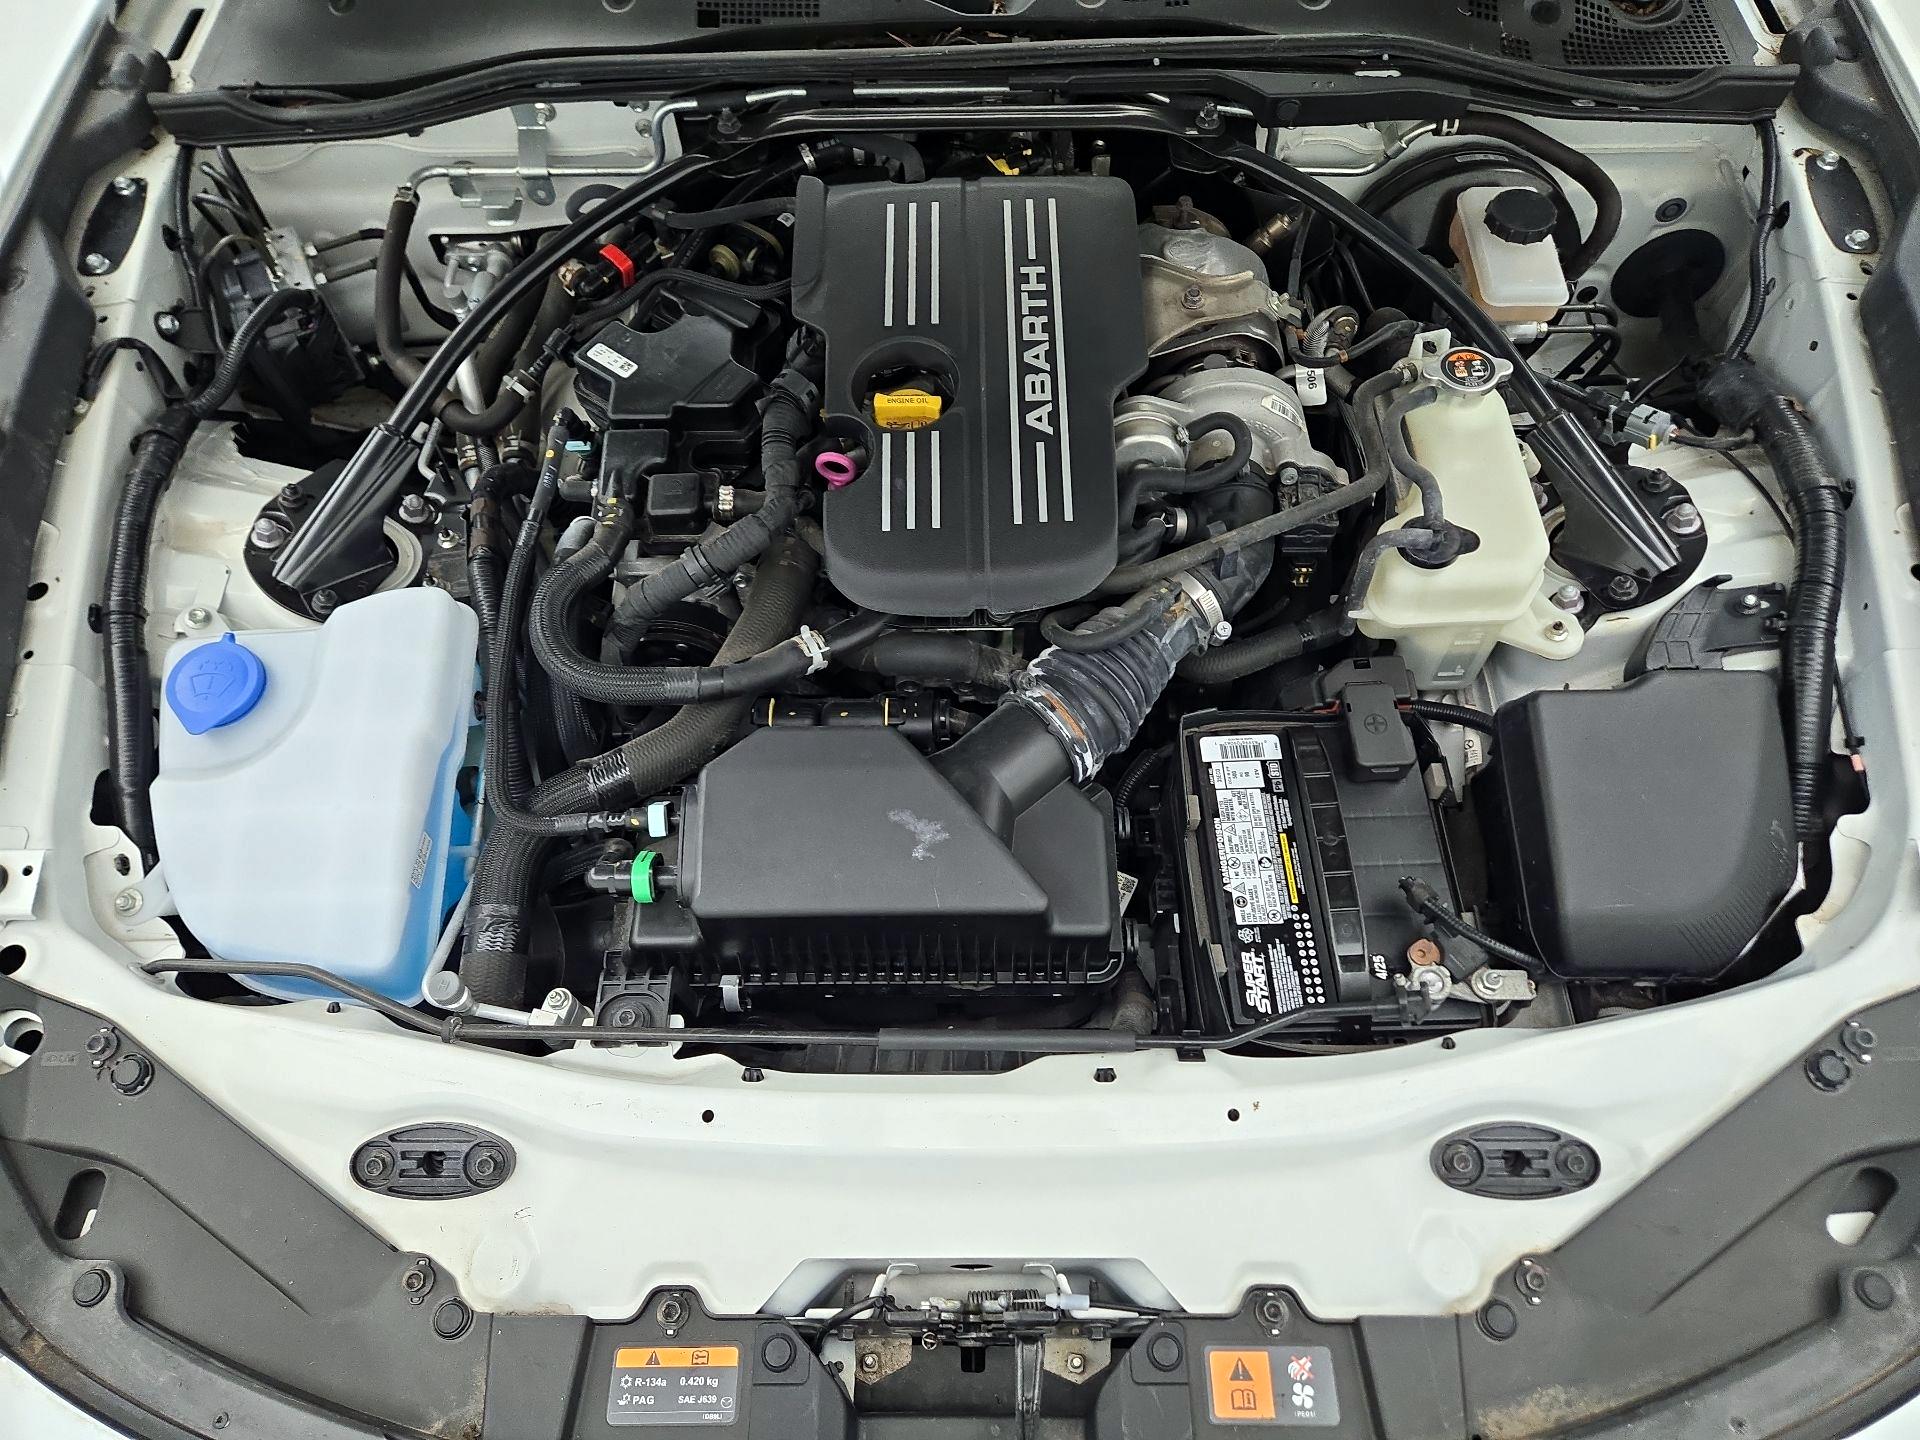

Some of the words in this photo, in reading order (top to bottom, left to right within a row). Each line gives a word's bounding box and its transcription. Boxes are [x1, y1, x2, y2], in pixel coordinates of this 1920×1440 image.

[1020, 265, 1053, 436] ABARTH
[1241, 951, 1257, 1006] SUPER
[1250, 951, 1271, 1014] START
[1372, 955, 1388, 980] 4/25
[633, 1395, 655, 1405] PAG
[678, 1395, 696, 1404] SAE
[698, 1394, 718, 1404] J639
[635, 1377, 667, 1387] R-134a
[680, 1376, 704, 1386] 0.420
[706, 1376, 719, 1388] kg
